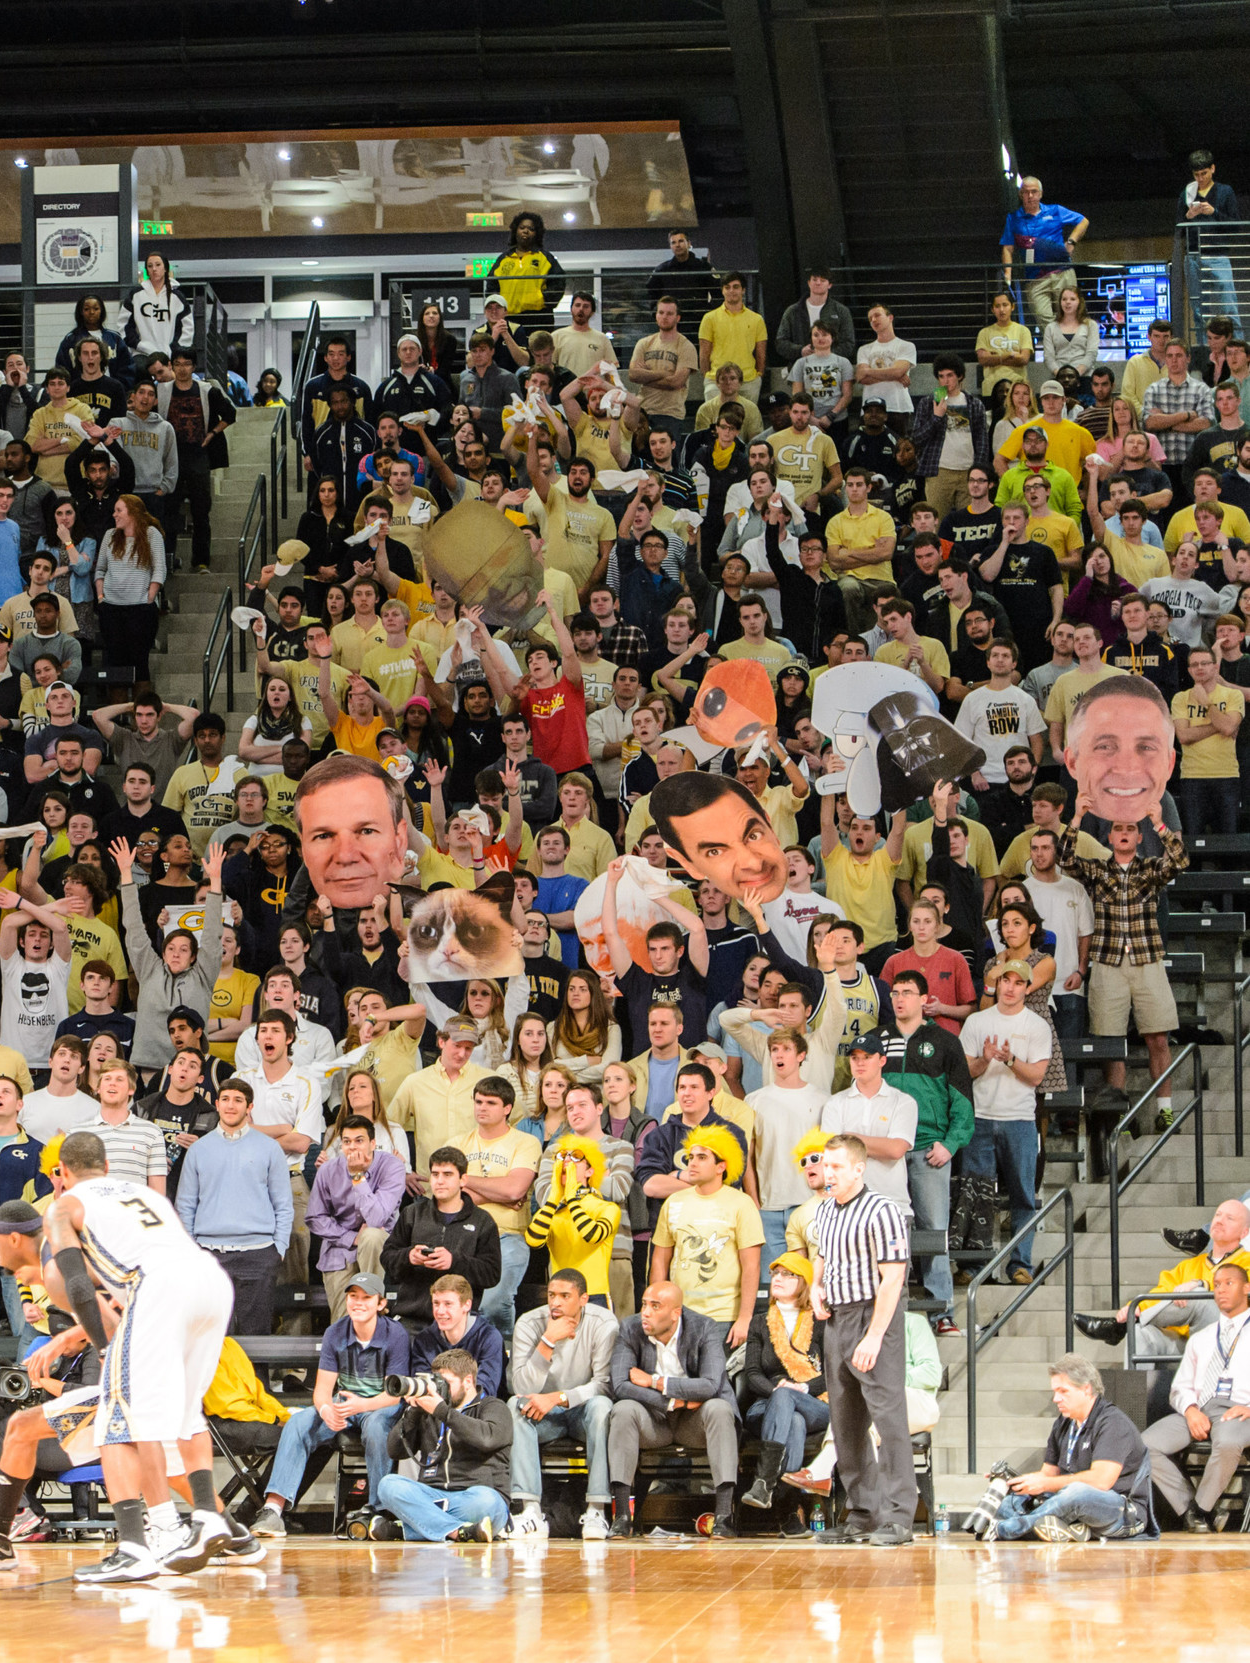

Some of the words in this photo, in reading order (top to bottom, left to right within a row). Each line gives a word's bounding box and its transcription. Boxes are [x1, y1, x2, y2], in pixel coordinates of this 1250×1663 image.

[42, 203, 81, 211] DIRECTORY
[989, 336, 1019, 351] GT
[806, 366, 838, 375] BUZZ
[812, 390, 833, 398] CUT
[122, 430, 160, 453] TECH
[777, 445, 817, 470] GT
[952, 523, 997, 541] TECH
[19, 622, 38, 630] TEC
[302, 702, 324, 713] TEC
[986, 707, 1020, 719] RAMBLIN'
[1188, 700, 1227, 716] THG
[988, 717, 1020, 735] ROW
[201, 798, 223, 812] GT
[539, 976, 559, 1000] TECH
[12, 1149, 29, 1160] GT
[119, 1198, 164, 1228] 3
